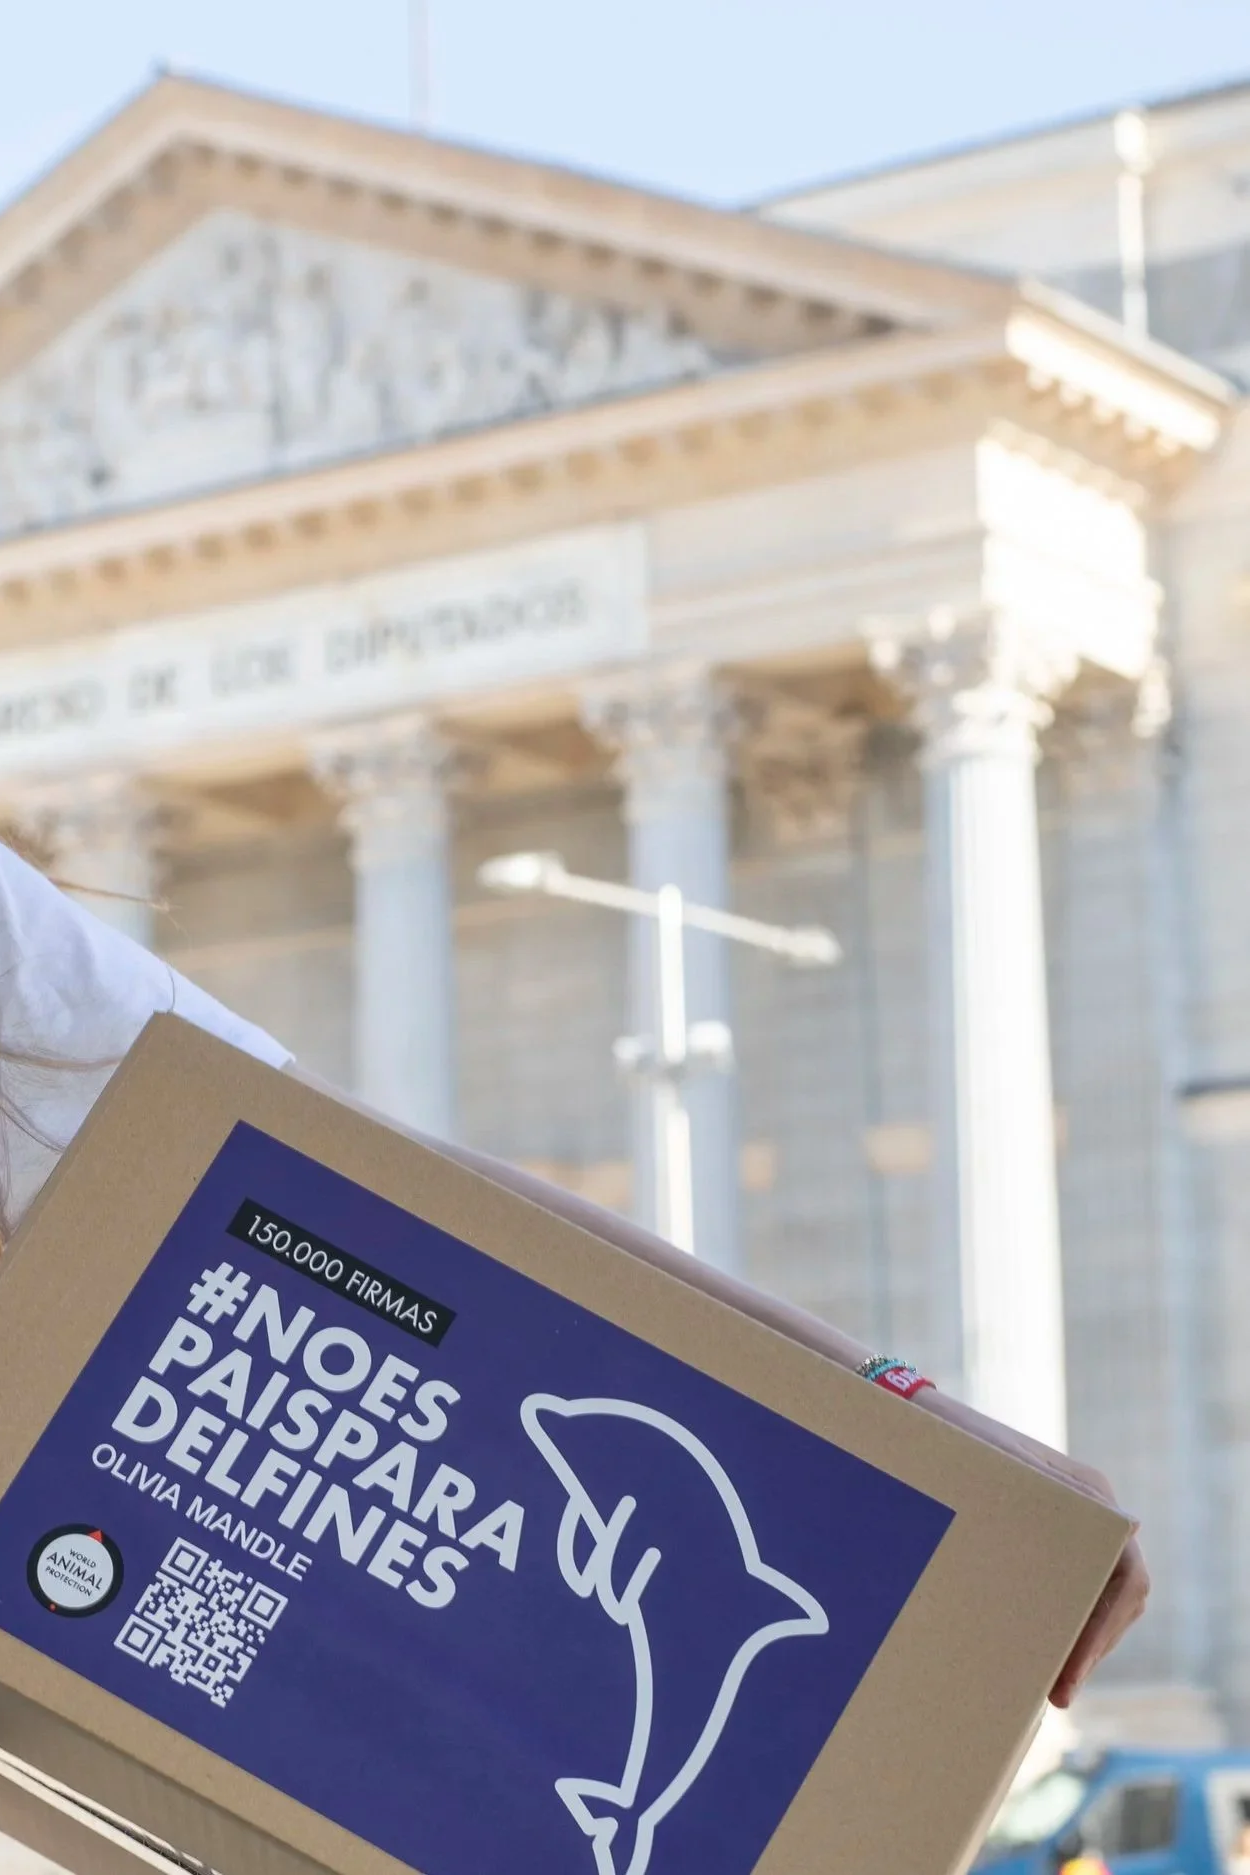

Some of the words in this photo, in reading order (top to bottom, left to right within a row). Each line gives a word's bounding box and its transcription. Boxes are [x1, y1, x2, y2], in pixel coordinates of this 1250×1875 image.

[248, 1214, 344, 1282] 150.000
[345, 1269, 438, 1333] FIRMAS
[186, 1261, 461, 1442] #NOES
[111, 1375, 470, 1609] DELFINES
[148, 1316, 525, 1573] PAISPARA
[46, 1551, 103, 1591] ANIMAL
[69, 1548, 97, 1569] WORLD
[91, 1443, 181, 1511] OLIVIA
[185, 1495, 313, 1582] MANDLE
[45, 1565, 93, 1597] PROTECTION
